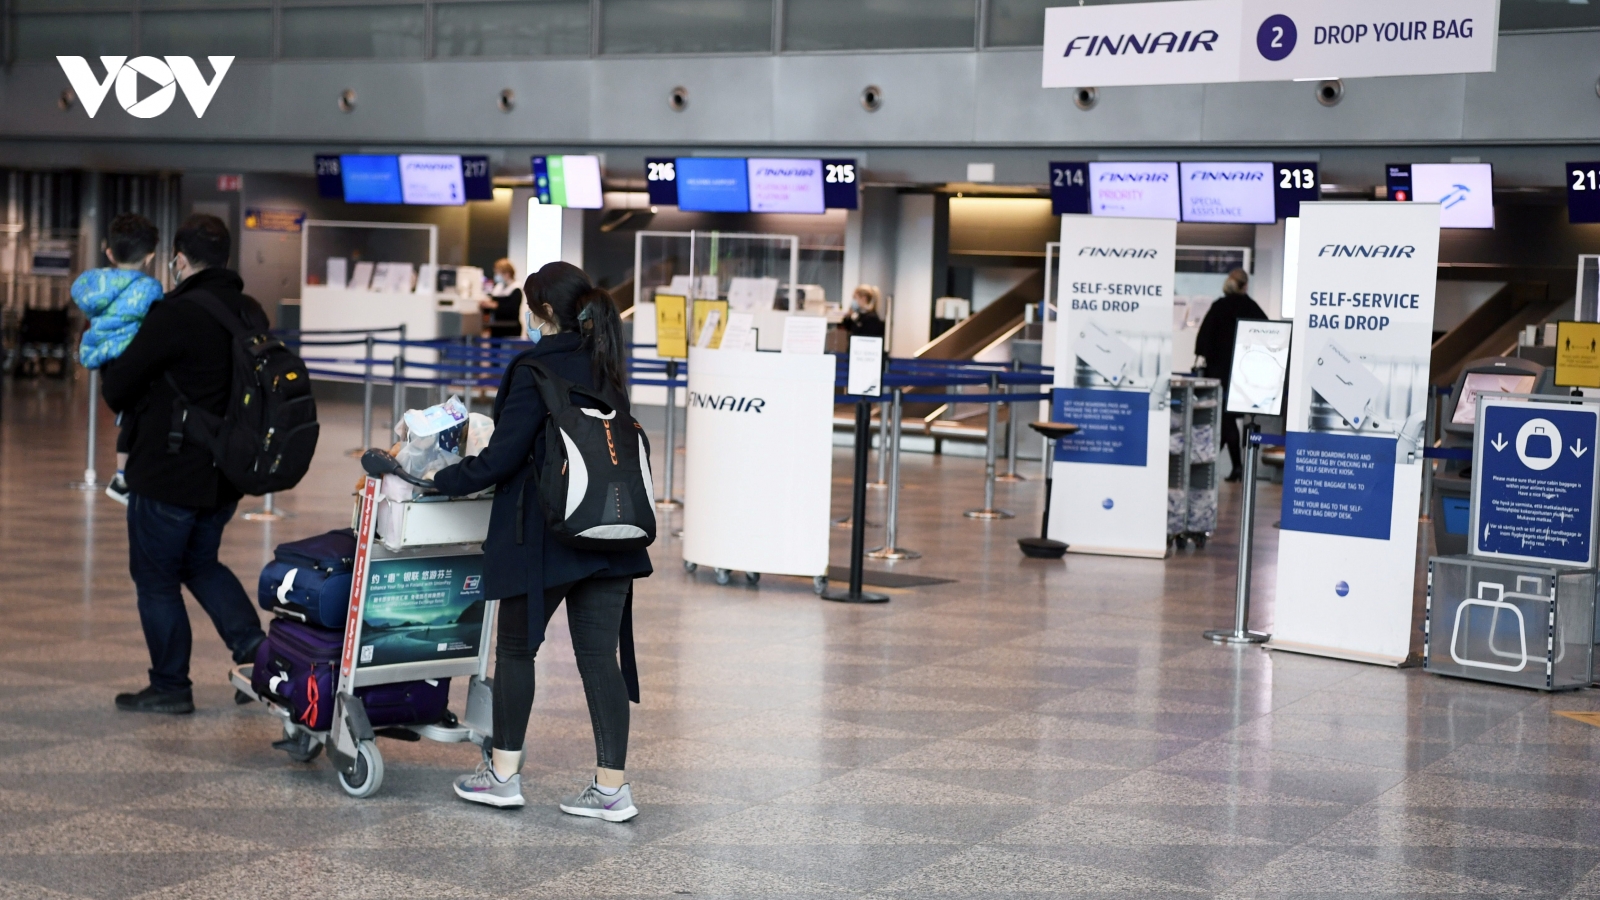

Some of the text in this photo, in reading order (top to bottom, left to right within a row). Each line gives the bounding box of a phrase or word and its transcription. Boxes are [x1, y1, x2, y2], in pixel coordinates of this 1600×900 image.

[1270, 26, 1284, 48] 2
[1314, 18, 1473, 45] DROP YOUR BAG
[1063, 30, 1219, 57] FINNAIR
[464, 160, 488, 178] 217
[648, 162, 676, 182] 216
[826, 164, 855, 184] 215
[1053, 168, 1084, 187] 214
[1100, 172, 1168, 183] FINNAIR
[1190, 170, 1264, 182] FINNAIR
[1280, 168, 1314, 190] 213
[1572, 170, 1600, 190] 21
[1100, 189, 1144, 200] PRIORITY
[1190, 206, 1242, 216] ASSISTANCE
[1078, 247, 1158, 259] FINNAIR
[1318, 244, 1416, 258] FINNAIR
[1072, 282, 1162, 297] SELF-SERVICE
[1072, 299, 1140, 312] BAG DROP
[1310, 292, 1420, 309] SELF-SERVICE
[1308, 314, 1390, 331] BAG DROP
[1306, 466, 1337, 475] SELF-SERVICE
[404, 571, 419, 582] 银联
